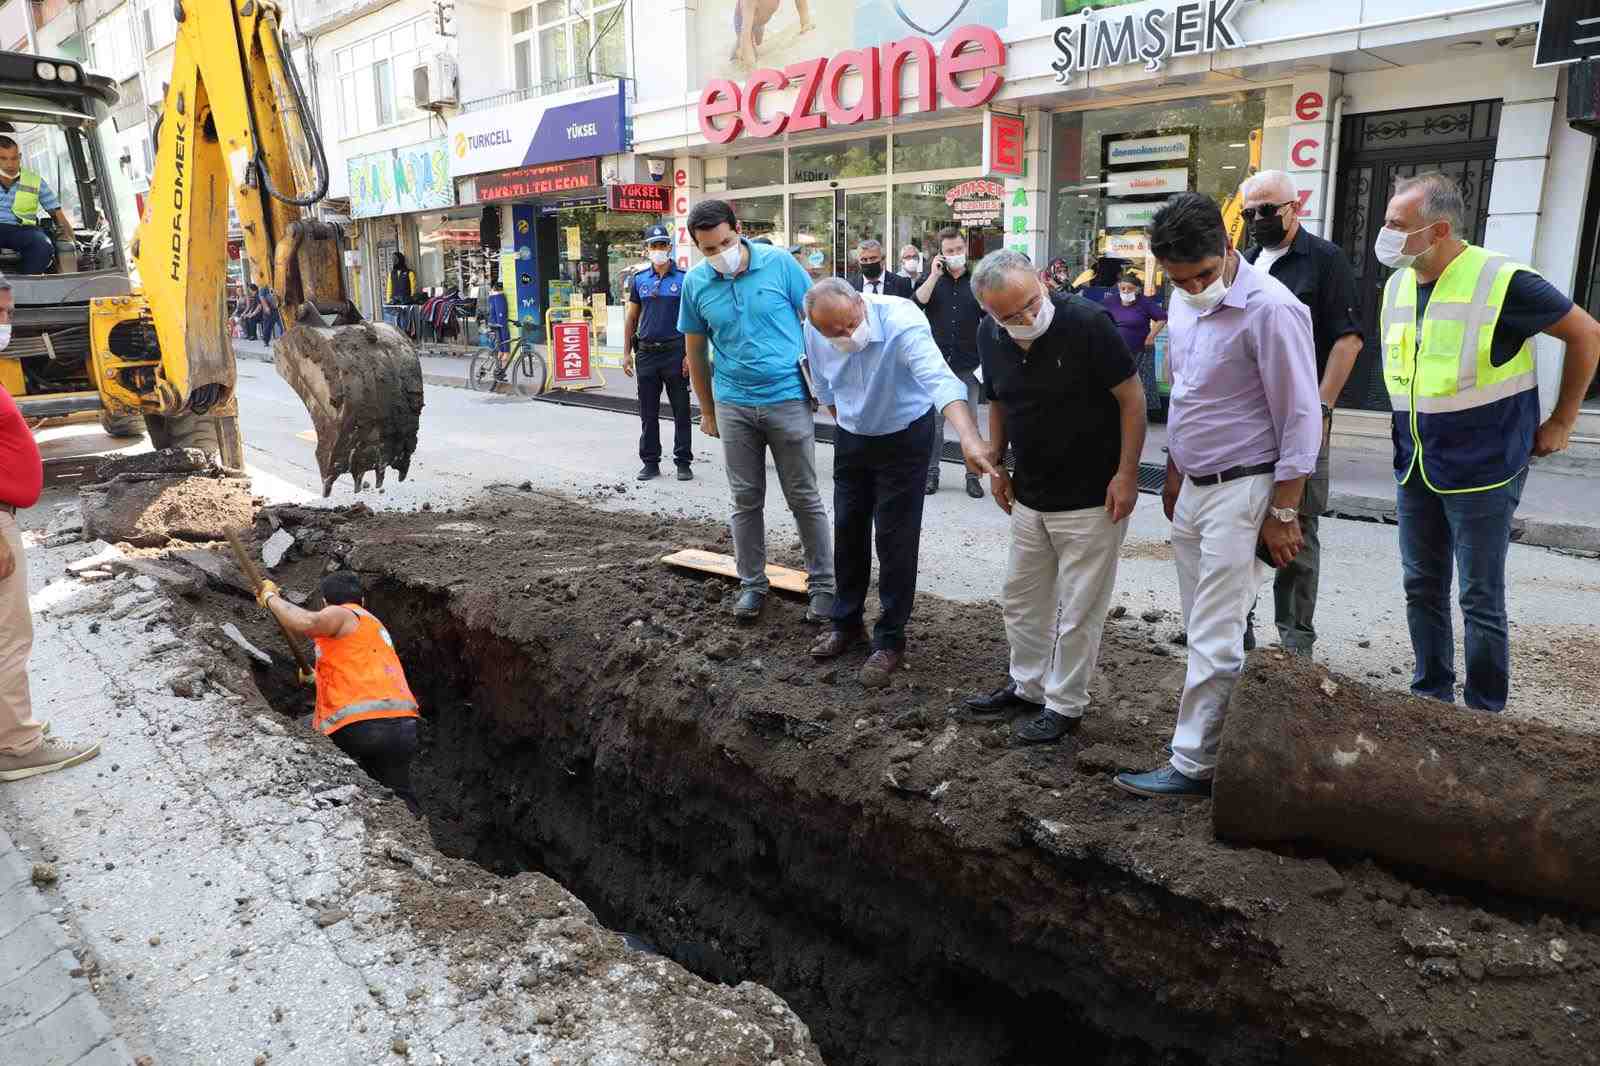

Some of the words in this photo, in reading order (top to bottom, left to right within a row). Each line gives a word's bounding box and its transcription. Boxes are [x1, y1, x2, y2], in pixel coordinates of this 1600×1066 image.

[1051, 0, 1237, 79] ŞİMŞEK
[698, 24, 1006, 144] eczane
[467, 129, 512, 151] TURKCELL
[566, 121, 598, 140] YÜKSEL
